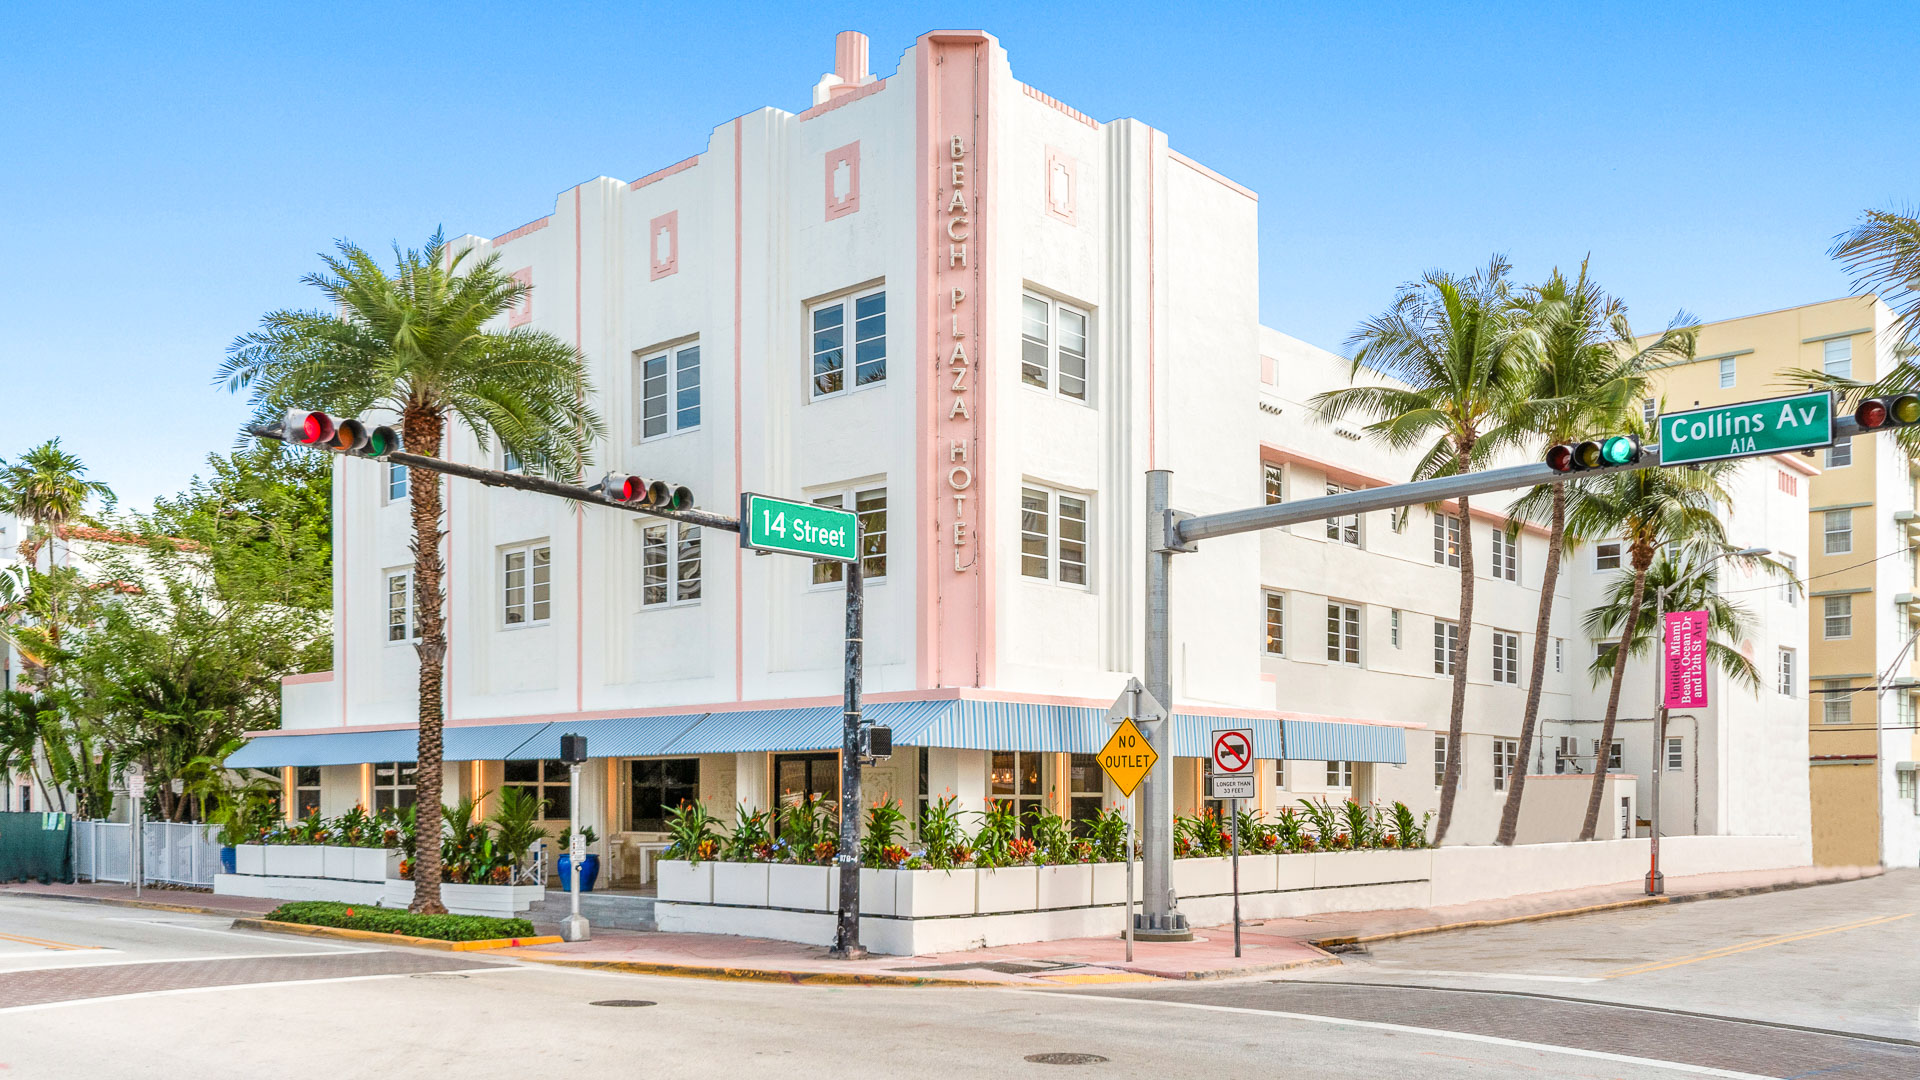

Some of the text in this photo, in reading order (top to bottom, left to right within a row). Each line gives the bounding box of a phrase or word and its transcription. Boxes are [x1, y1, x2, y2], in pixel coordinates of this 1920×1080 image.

[948, 135, 972, 572] BEACH PLAZA HOTEL
[1671, 403, 1817, 443] Collins Av
[1730, 436, 1756, 454] A1A
[763, 509, 846, 548] 14 Street
[1671, 621, 1681, 700] Untitled Miami
[1681, 616, 1692, 704] Beach, Ocean Dr
[1692, 621, 1702, 698] and 12th St Art
[1105, 754, 1150, 768] OUTLET
[1118, 735, 1136, 749] NO
